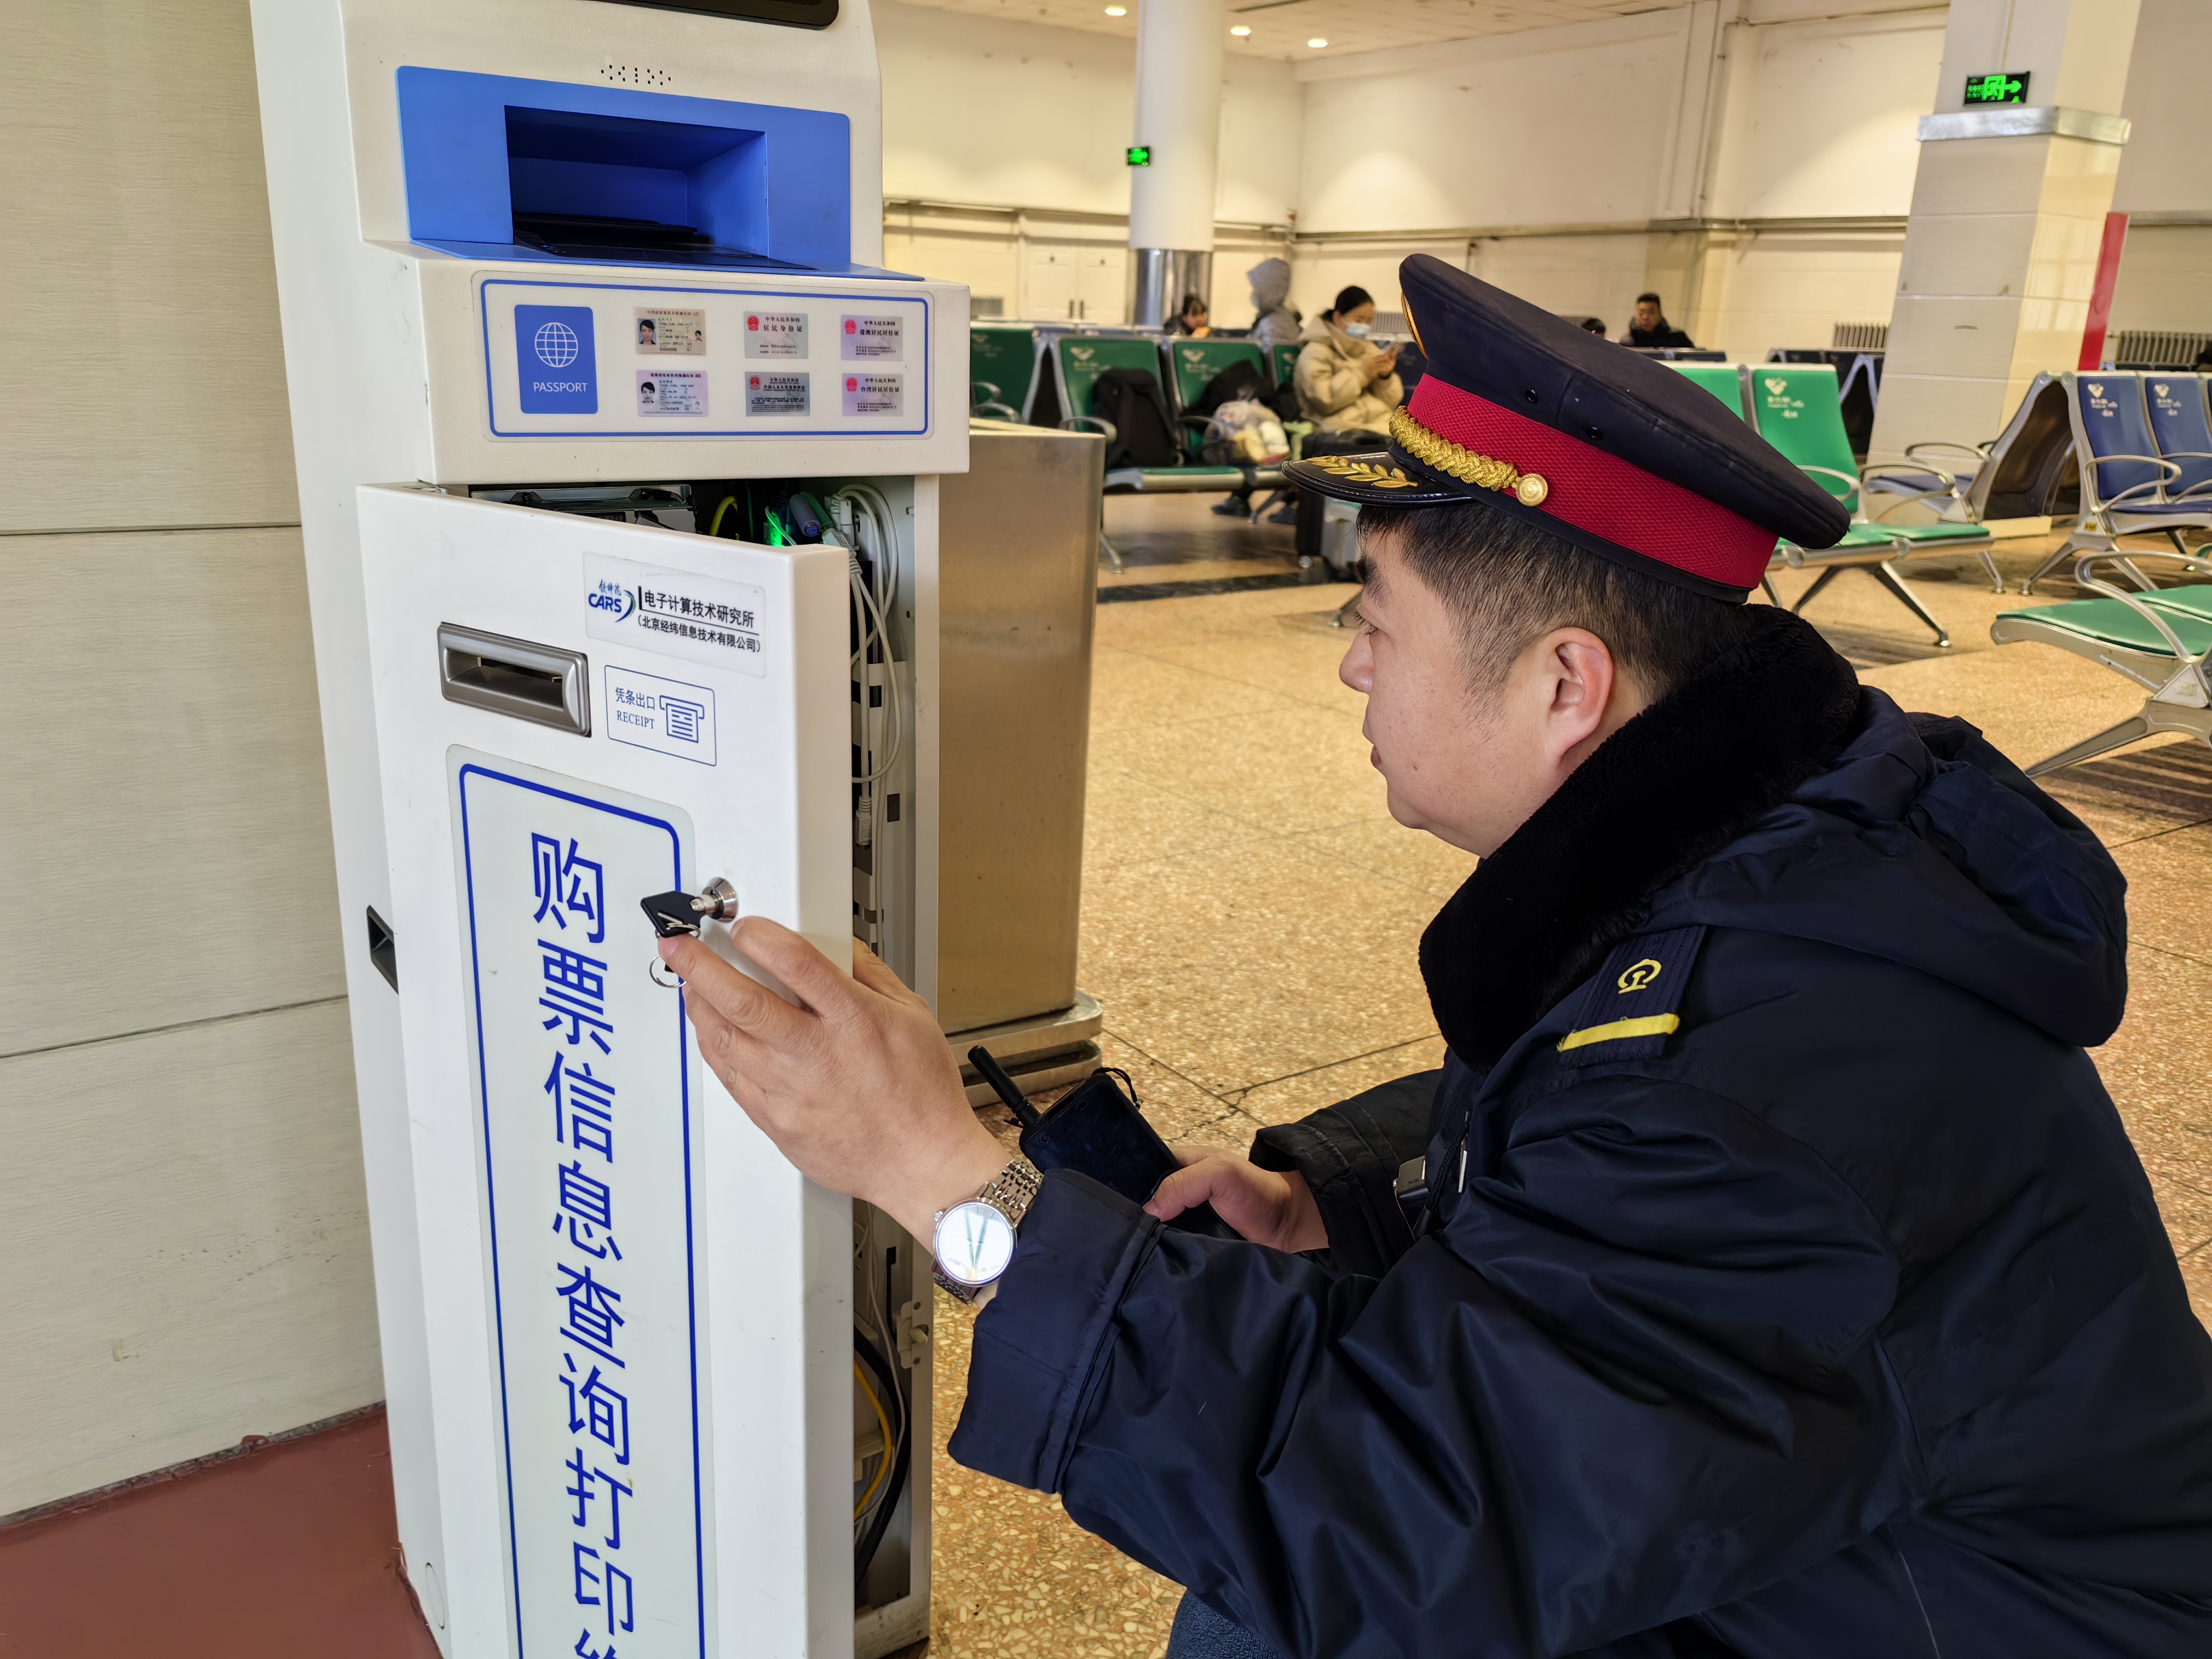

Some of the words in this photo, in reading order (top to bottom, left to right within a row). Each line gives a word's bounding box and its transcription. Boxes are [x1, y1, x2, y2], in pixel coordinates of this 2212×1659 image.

[533, 382, 588, 392] PASSPORT
[589, 593, 622, 613] CARS
[644, 590, 754, 628] 电子计算技术研究所
[615, 687, 655, 711] 凭条出口
[616, 710, 655, 729] RECEIPT
[531, 831, 634, 1659] 购票信息查询打印
